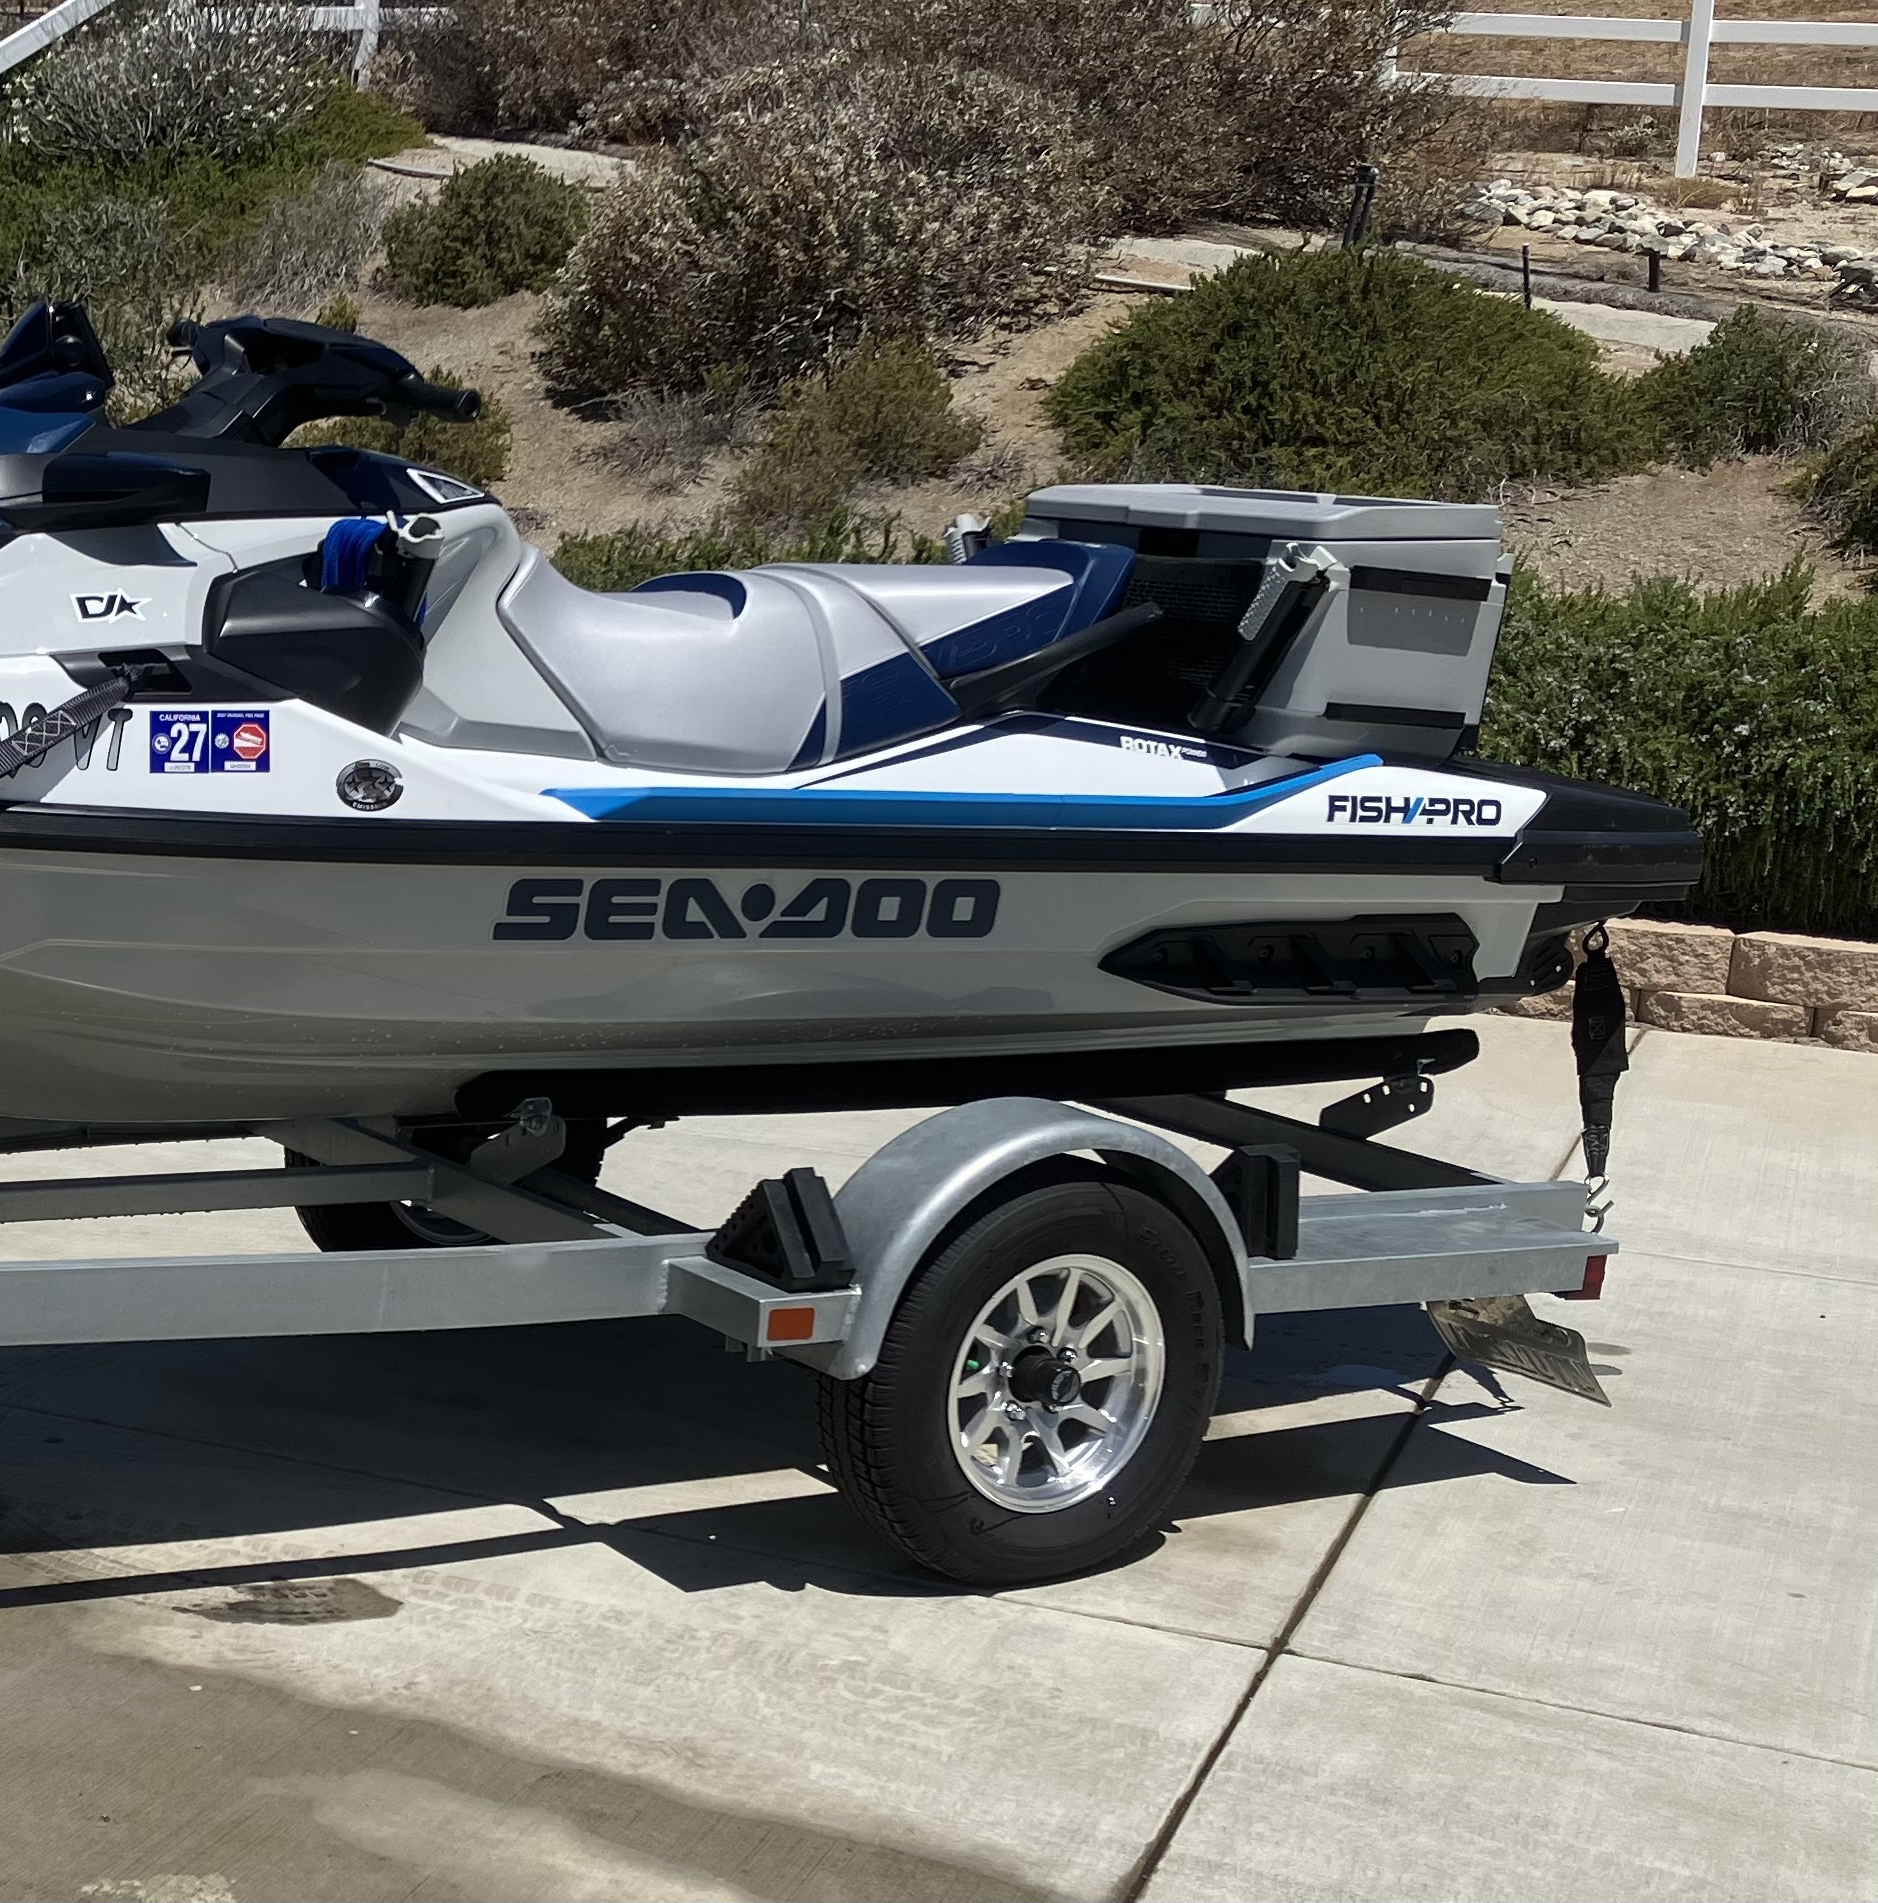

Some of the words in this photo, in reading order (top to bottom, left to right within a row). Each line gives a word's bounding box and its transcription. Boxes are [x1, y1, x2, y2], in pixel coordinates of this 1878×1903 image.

[159, 713, 201, 722] CALIFORNIA
[169, 722, 208, 762] 27
[1120, 735, 1184, 761] ROTAX
